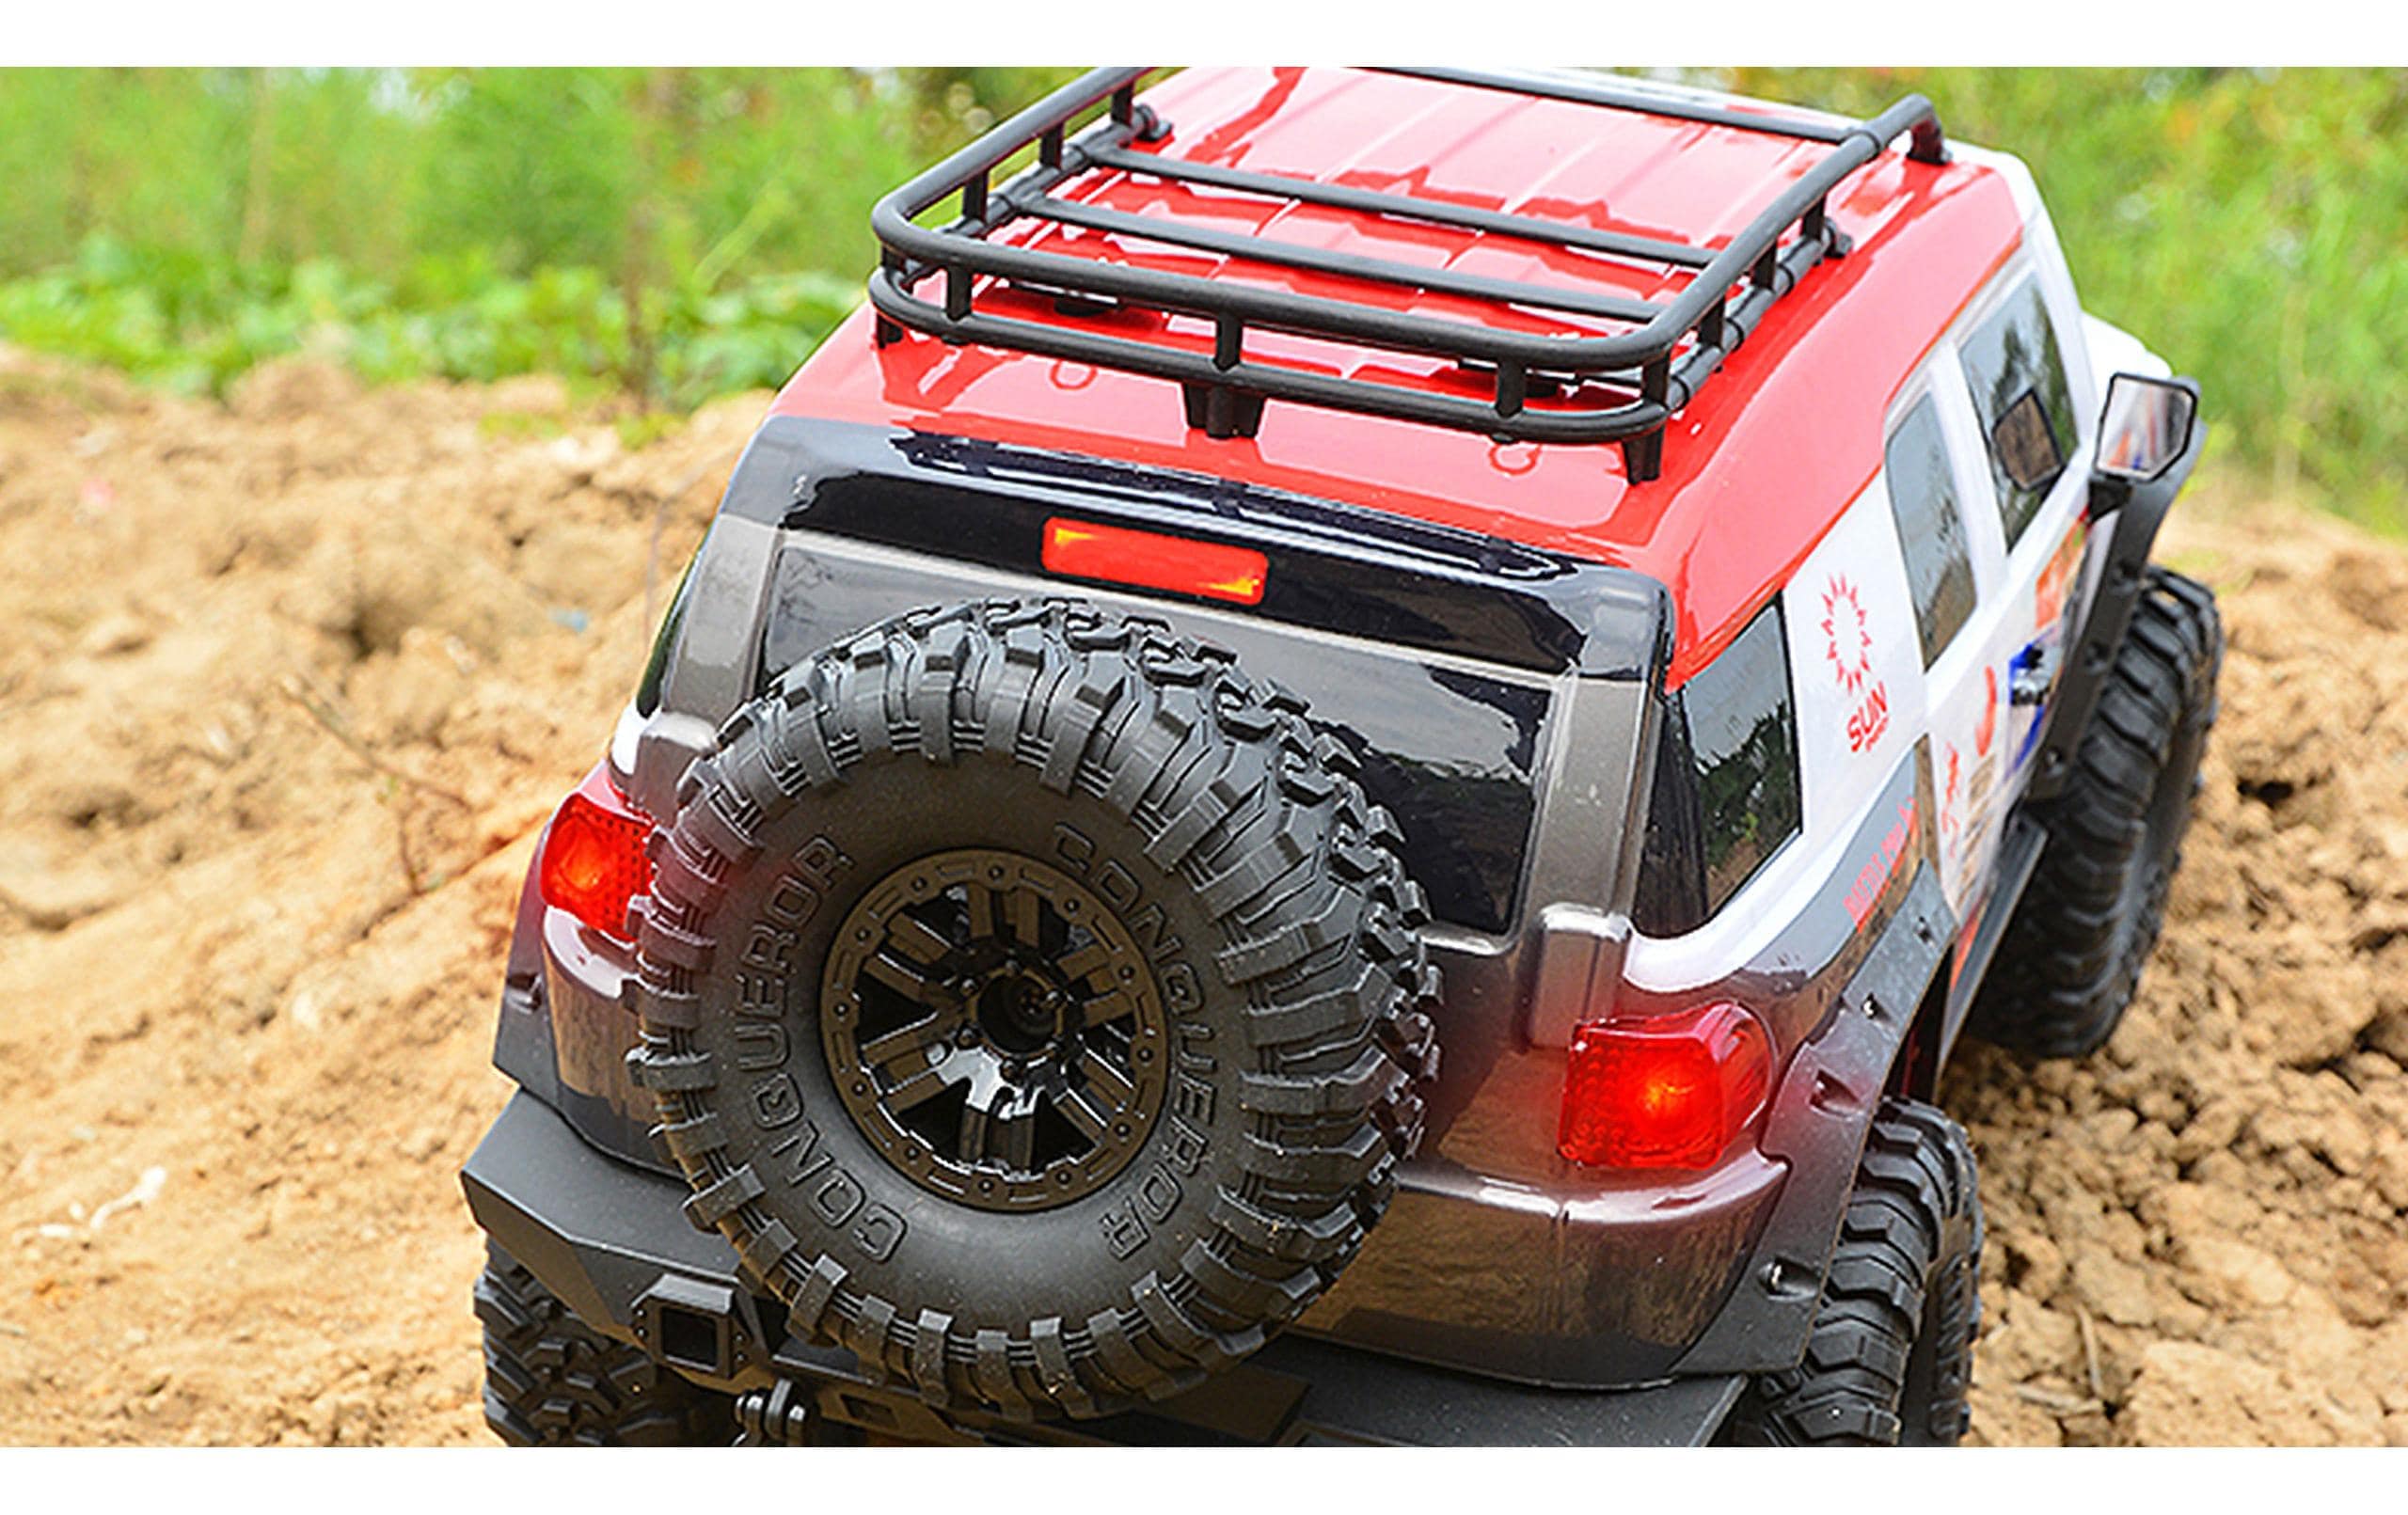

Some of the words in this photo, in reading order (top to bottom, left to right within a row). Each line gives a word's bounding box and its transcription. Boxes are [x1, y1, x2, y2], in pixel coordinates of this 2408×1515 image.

[1846, 680, 1887, 752] SUN
[735, 835, 908, 1262] CONQUEROR
[1054, 821, 1216, 1259] CONQUEROR
